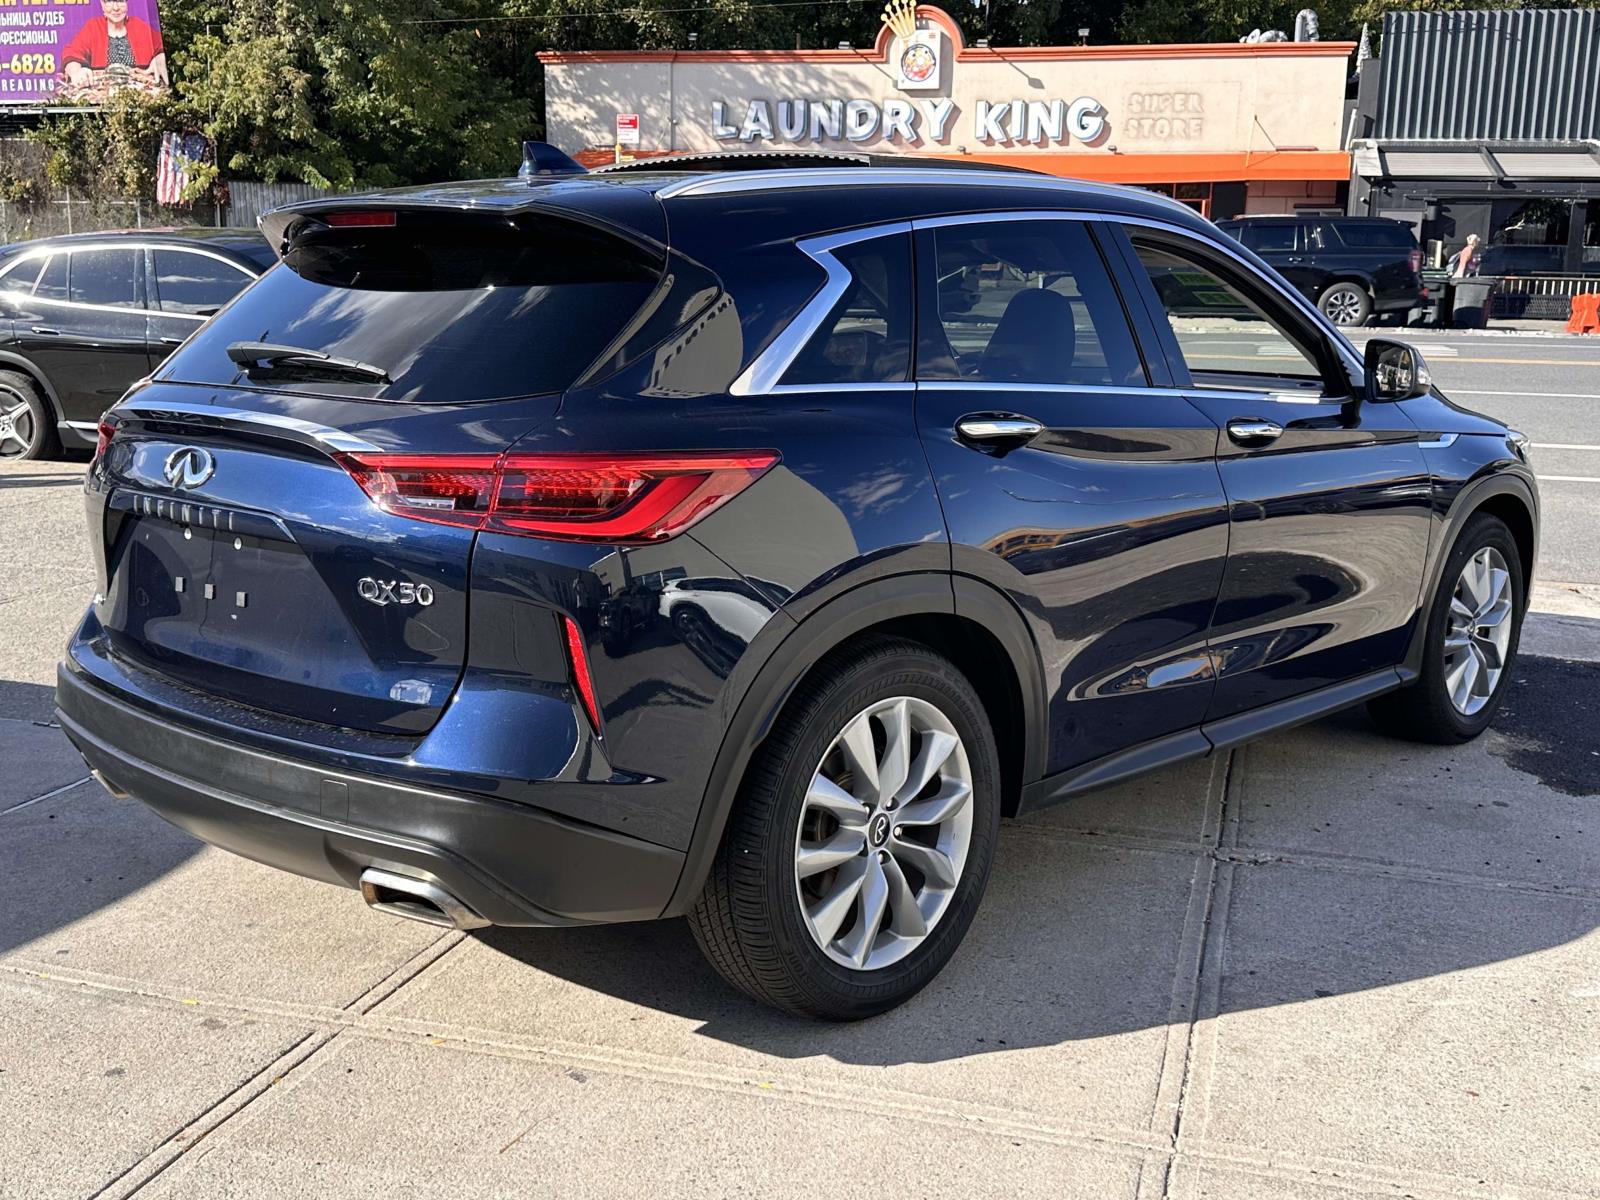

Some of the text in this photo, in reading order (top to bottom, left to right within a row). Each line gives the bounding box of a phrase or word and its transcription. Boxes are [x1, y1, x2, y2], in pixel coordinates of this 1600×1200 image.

[0, 11, 65, 27] ЬНИЦА СУДЕБ
[0, 30, 58, 45] ФЕССИОНАЛ
[0, 53, 56, 75] -6828
[1, 78, 55, 92] READING
[1129, 92, 1204, 113] SUPER
[711, 96, 1104, 143] LAUNDRY KING
[1124, 117, 1203, 139] STORE
[133, 494, 235, 531] INFINITI
[357, 576, 434, 607] QX50
